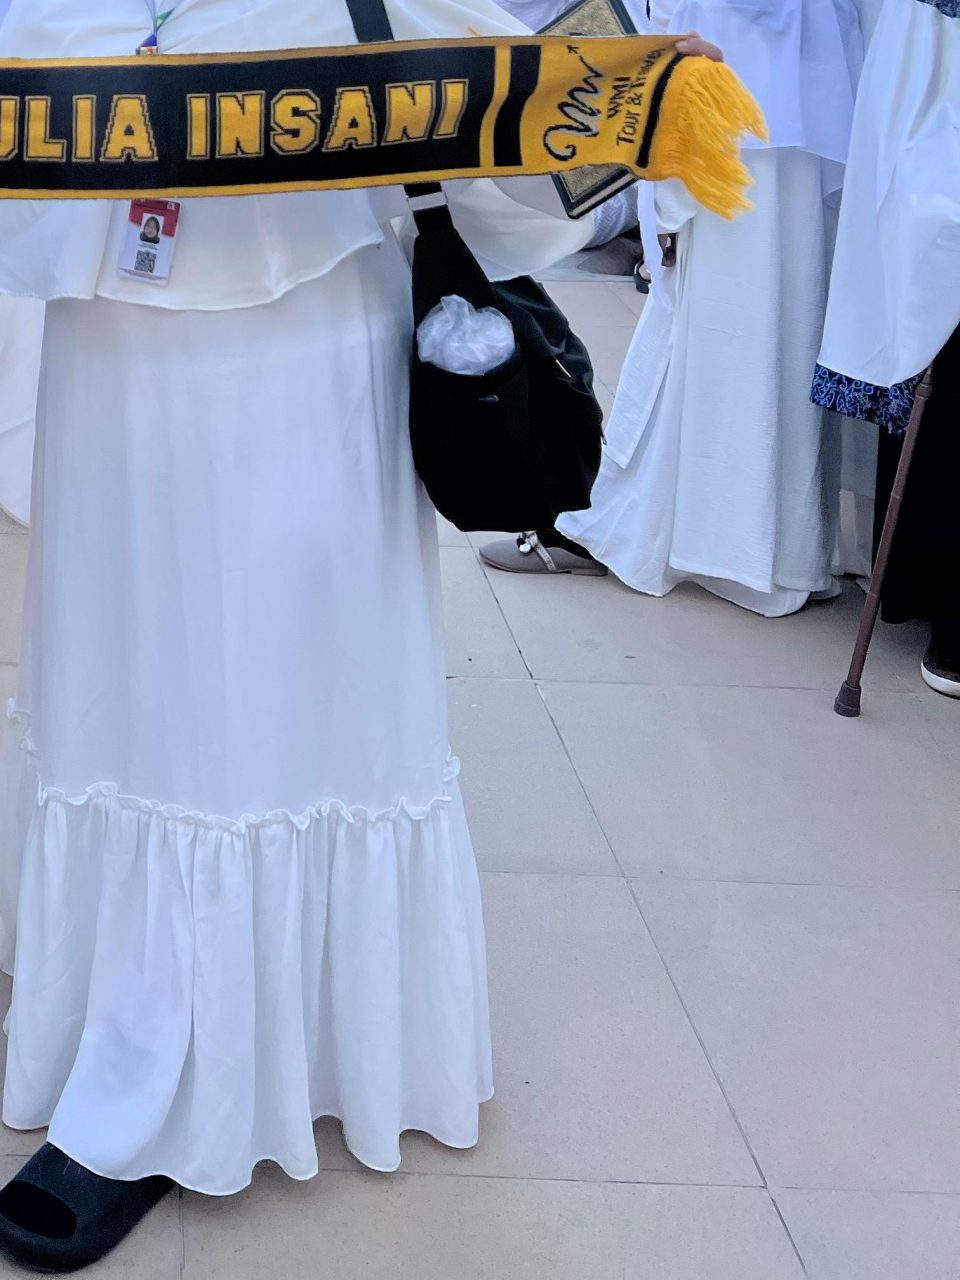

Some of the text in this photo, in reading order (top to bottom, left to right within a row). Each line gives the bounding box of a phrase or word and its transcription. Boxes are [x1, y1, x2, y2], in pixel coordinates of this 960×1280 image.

[606, 76, 631, 120] WMI
[626, 93, 643, 106] &
[186, 79, 469, 160] INSANI
[616, 110, 641, 146] Tour
